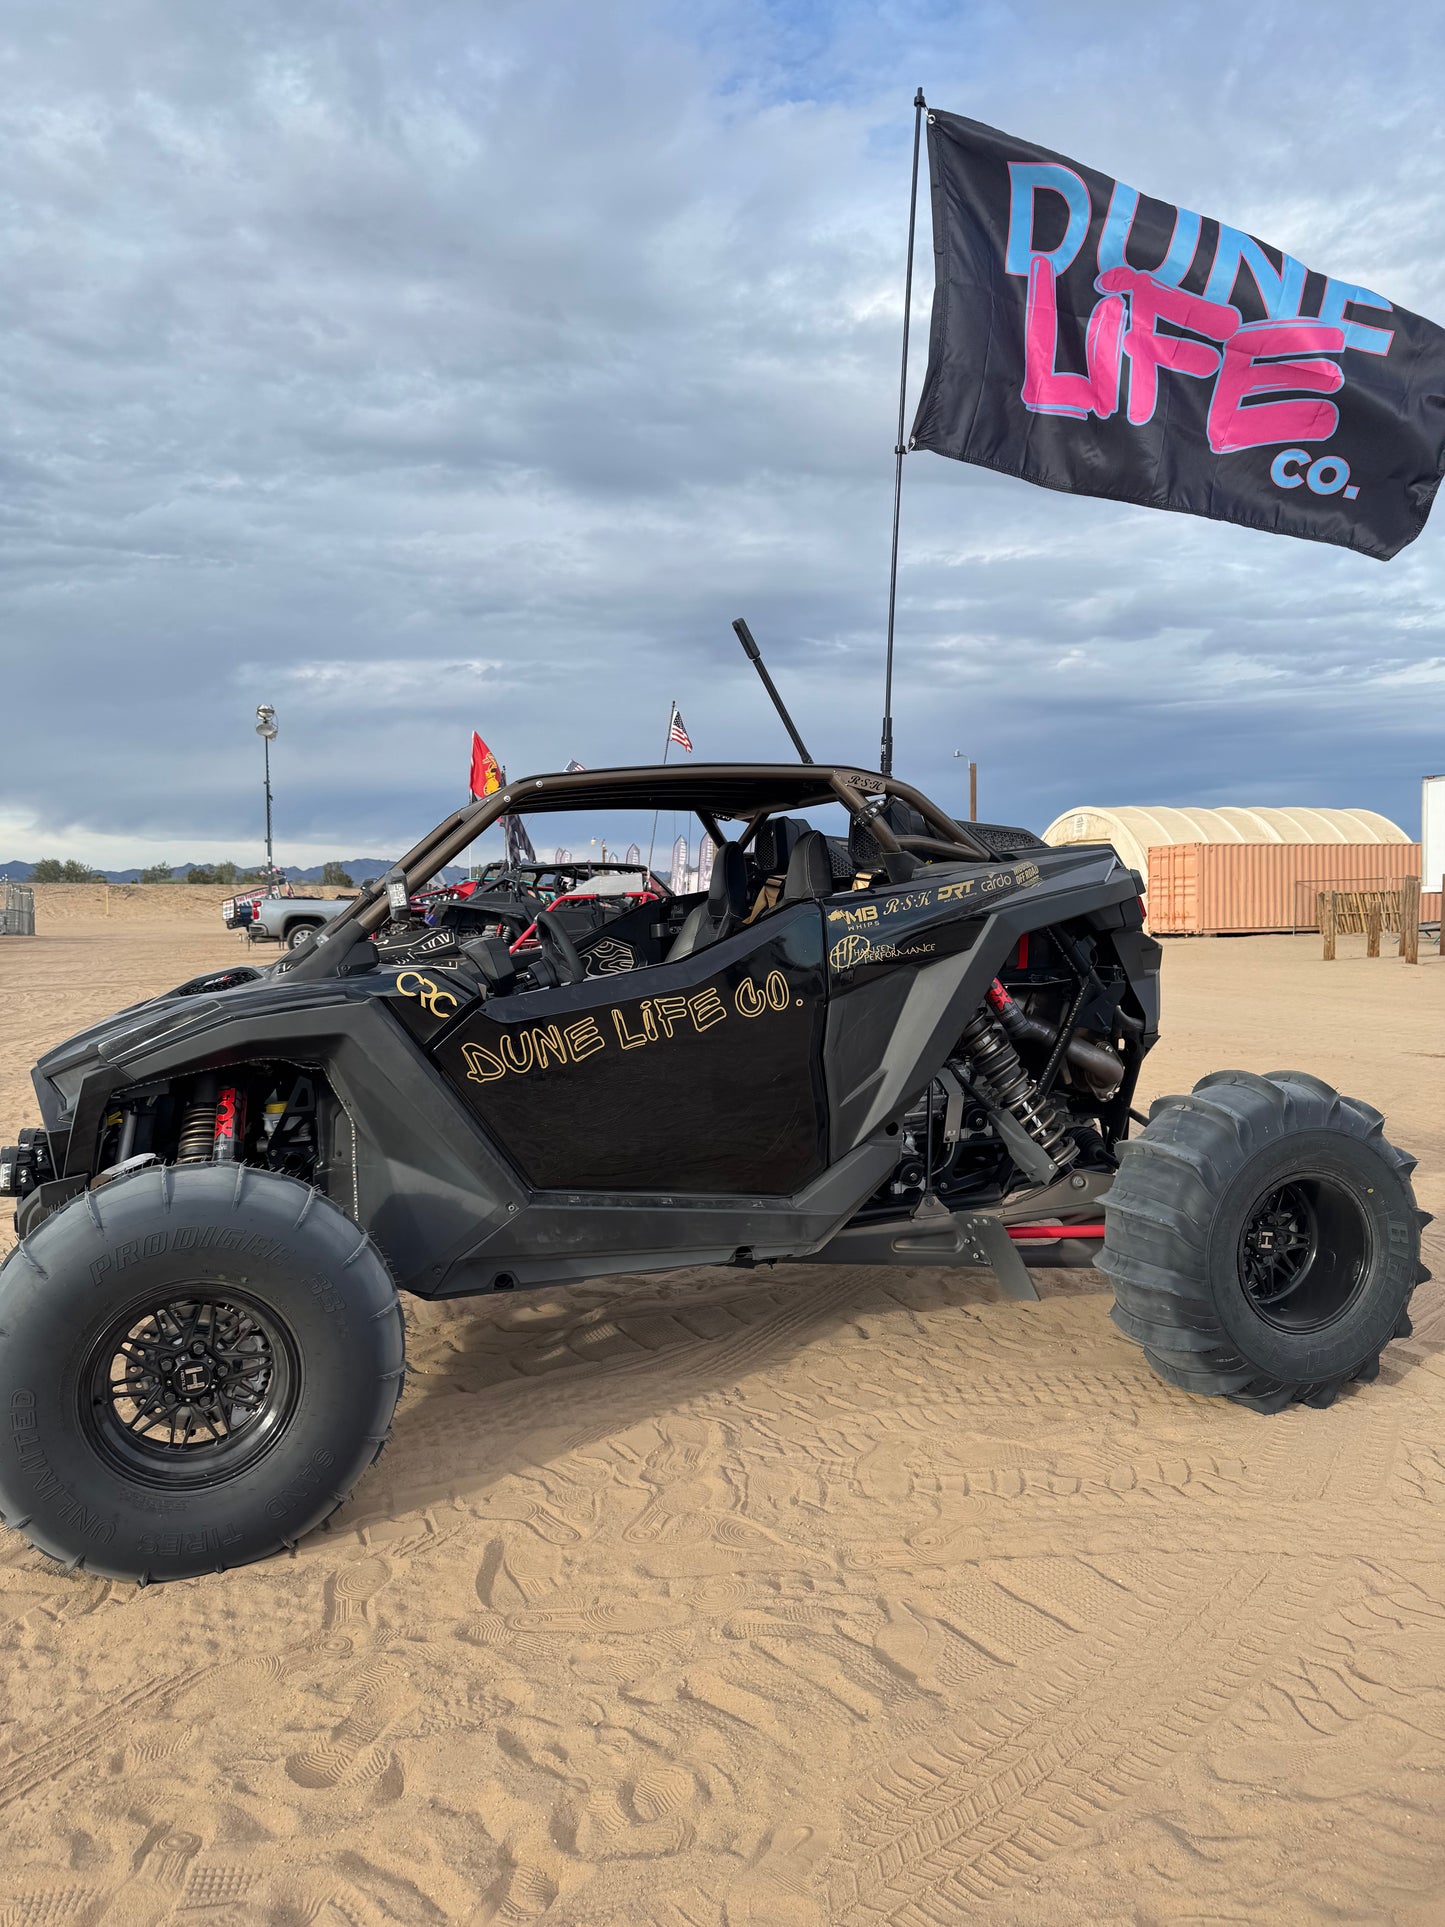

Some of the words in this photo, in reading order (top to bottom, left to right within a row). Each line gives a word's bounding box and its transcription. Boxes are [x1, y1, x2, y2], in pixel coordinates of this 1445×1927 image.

[1270, 448, 1361, 501] CO.
[980, 874, 1012, 892] cardo
[847, 920, 880, 931] WHIPS
[461, 1017, 605, 1083] DUNE
[9, 1387, 118, 1545] UNLIMITED
[136, 1522, 246, 1557] TIRES
